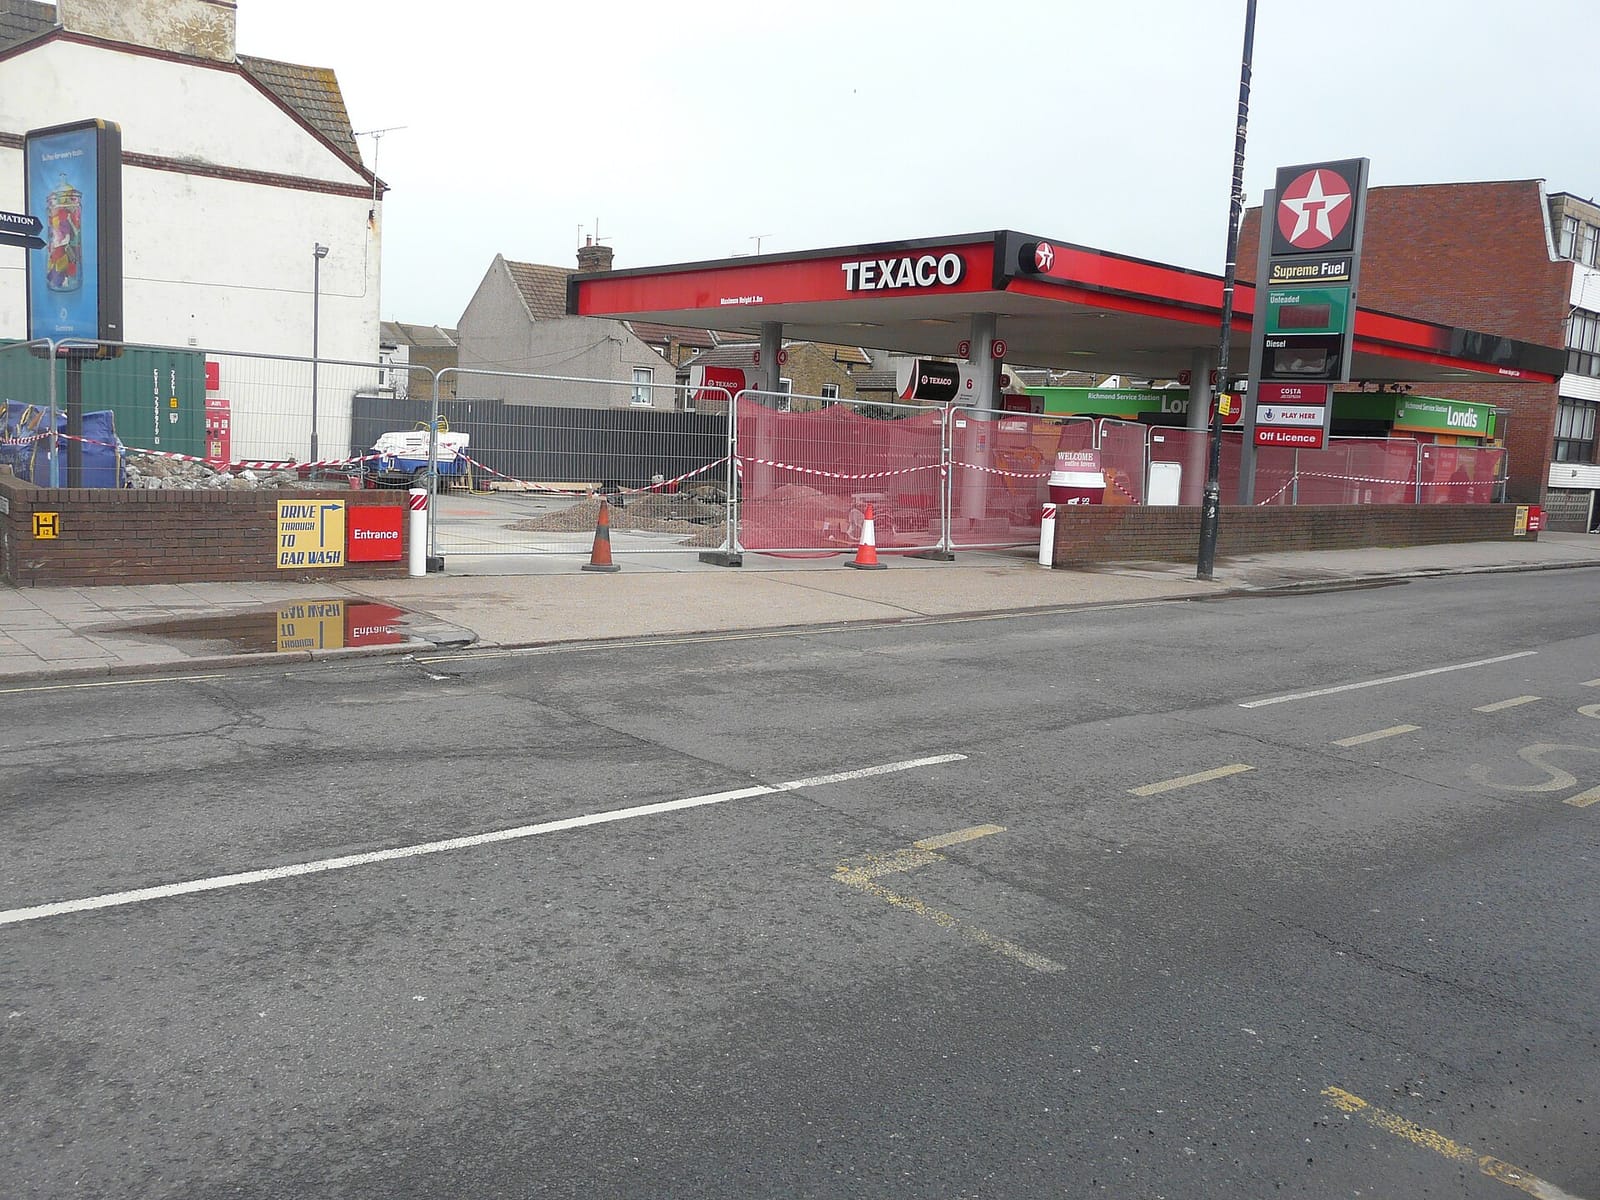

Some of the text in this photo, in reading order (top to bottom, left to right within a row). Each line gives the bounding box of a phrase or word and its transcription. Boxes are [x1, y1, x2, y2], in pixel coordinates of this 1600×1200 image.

[841, 253, 961, 291] TEXACO
[1273, 261, 1345, 279] Supreme Fuel
[1270, 295, 1300, 304] Unleaded
[1266, 339, 1286, 348] Diesel
[929, 377, 952, 385] TEXACO
[966, 379, 973, 389] 6
[1447, 406, 1478, 428] Londis
[1260, 432, 1316, 443] Off Licence
[1057, 451, 1094, 461] WELCOME
[281, 505, 317, 518] DRIVE
[281, 522, 316, 531] THROUGH
[354, 529, 399, 540] Entrance
[281, 534, 296, 548] TO
[280, 550, 341, 565] CAR WASH
